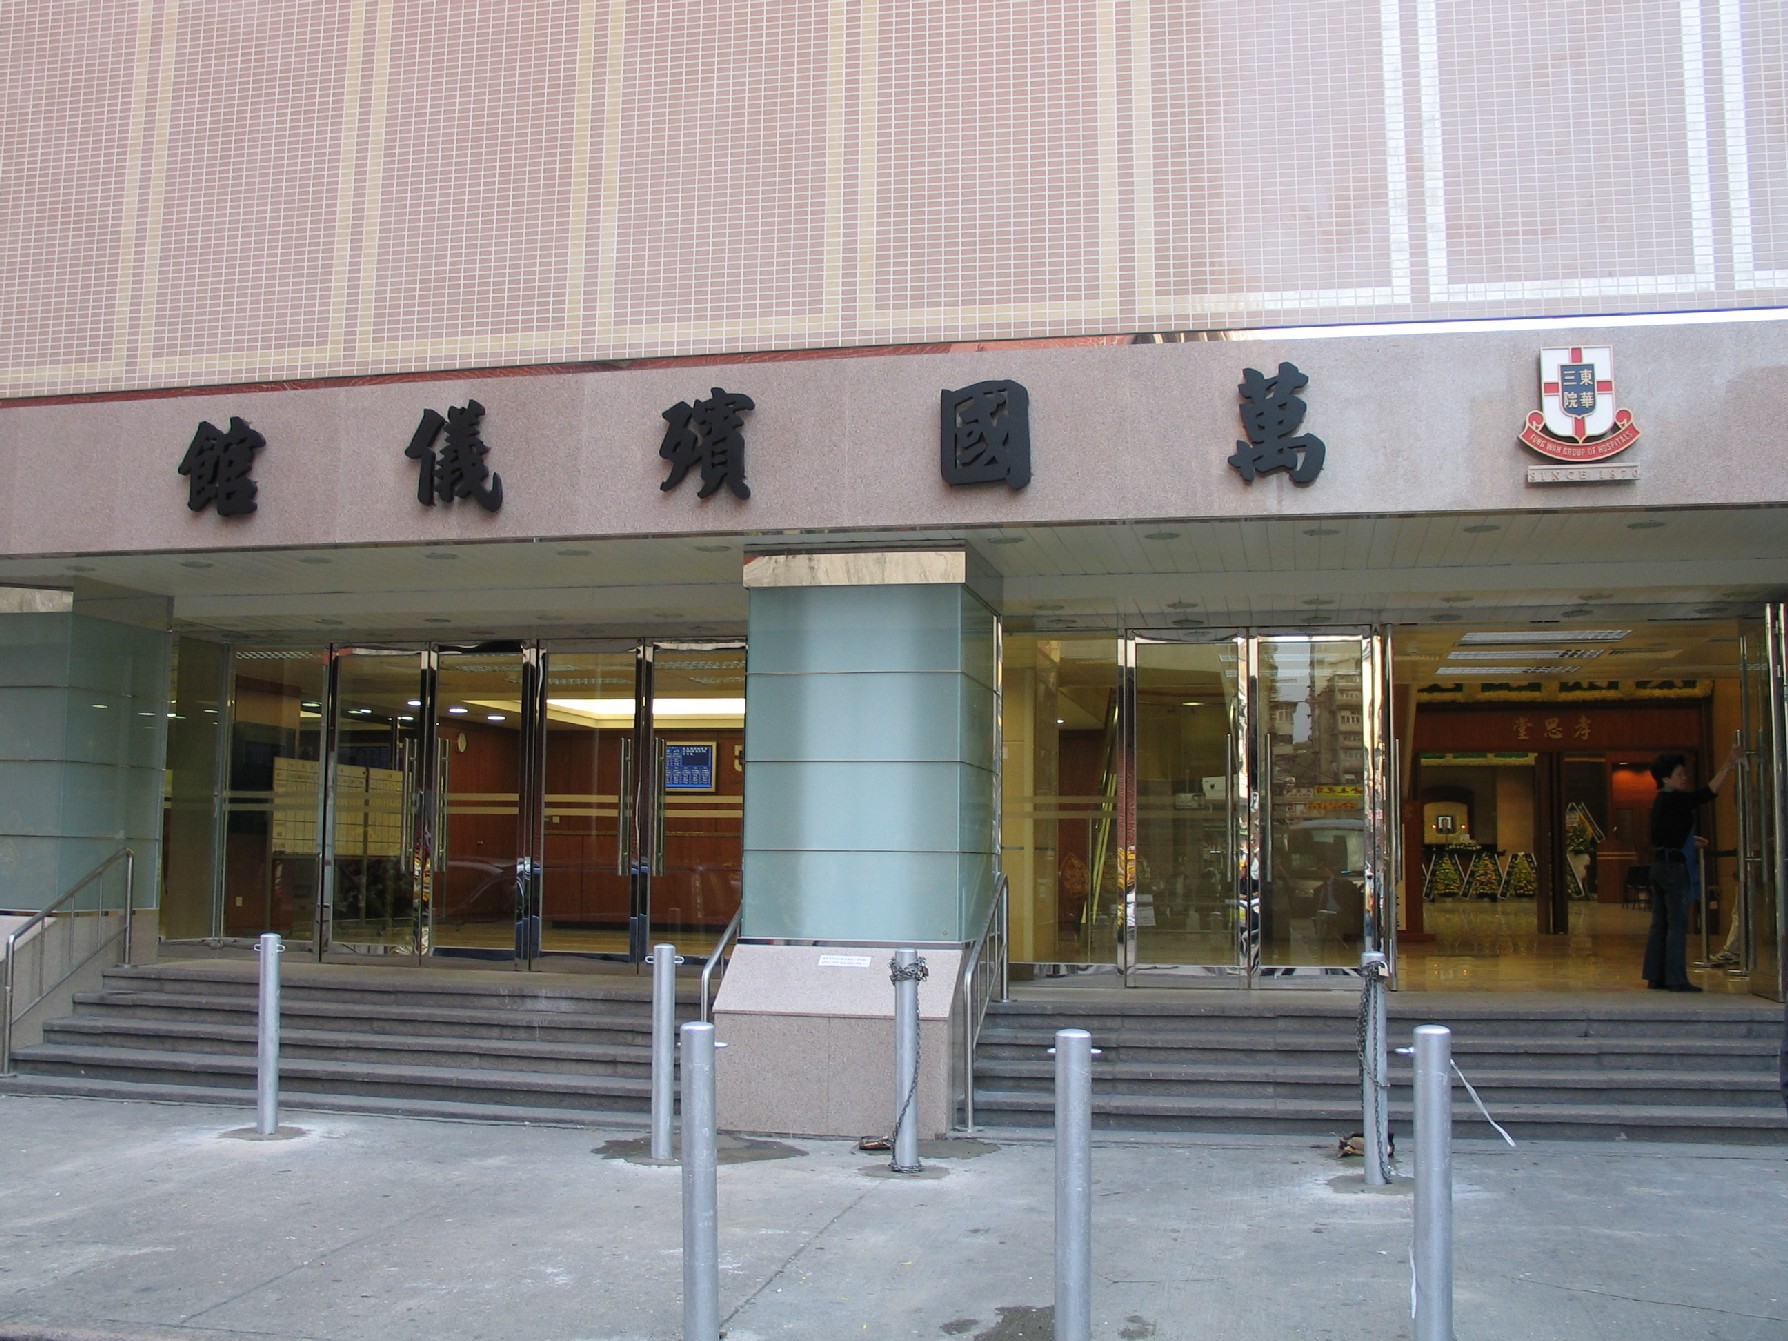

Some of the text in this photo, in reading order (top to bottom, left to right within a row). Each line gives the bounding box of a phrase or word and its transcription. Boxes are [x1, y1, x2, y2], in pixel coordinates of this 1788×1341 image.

[178, 361, 1326, 517] 萬國殯儀館
[1530, 431, 1633, 457] TUNG WAH GROUP OF HOSPITALS
[1529, 470, 1639, 481] SINCE 1870
